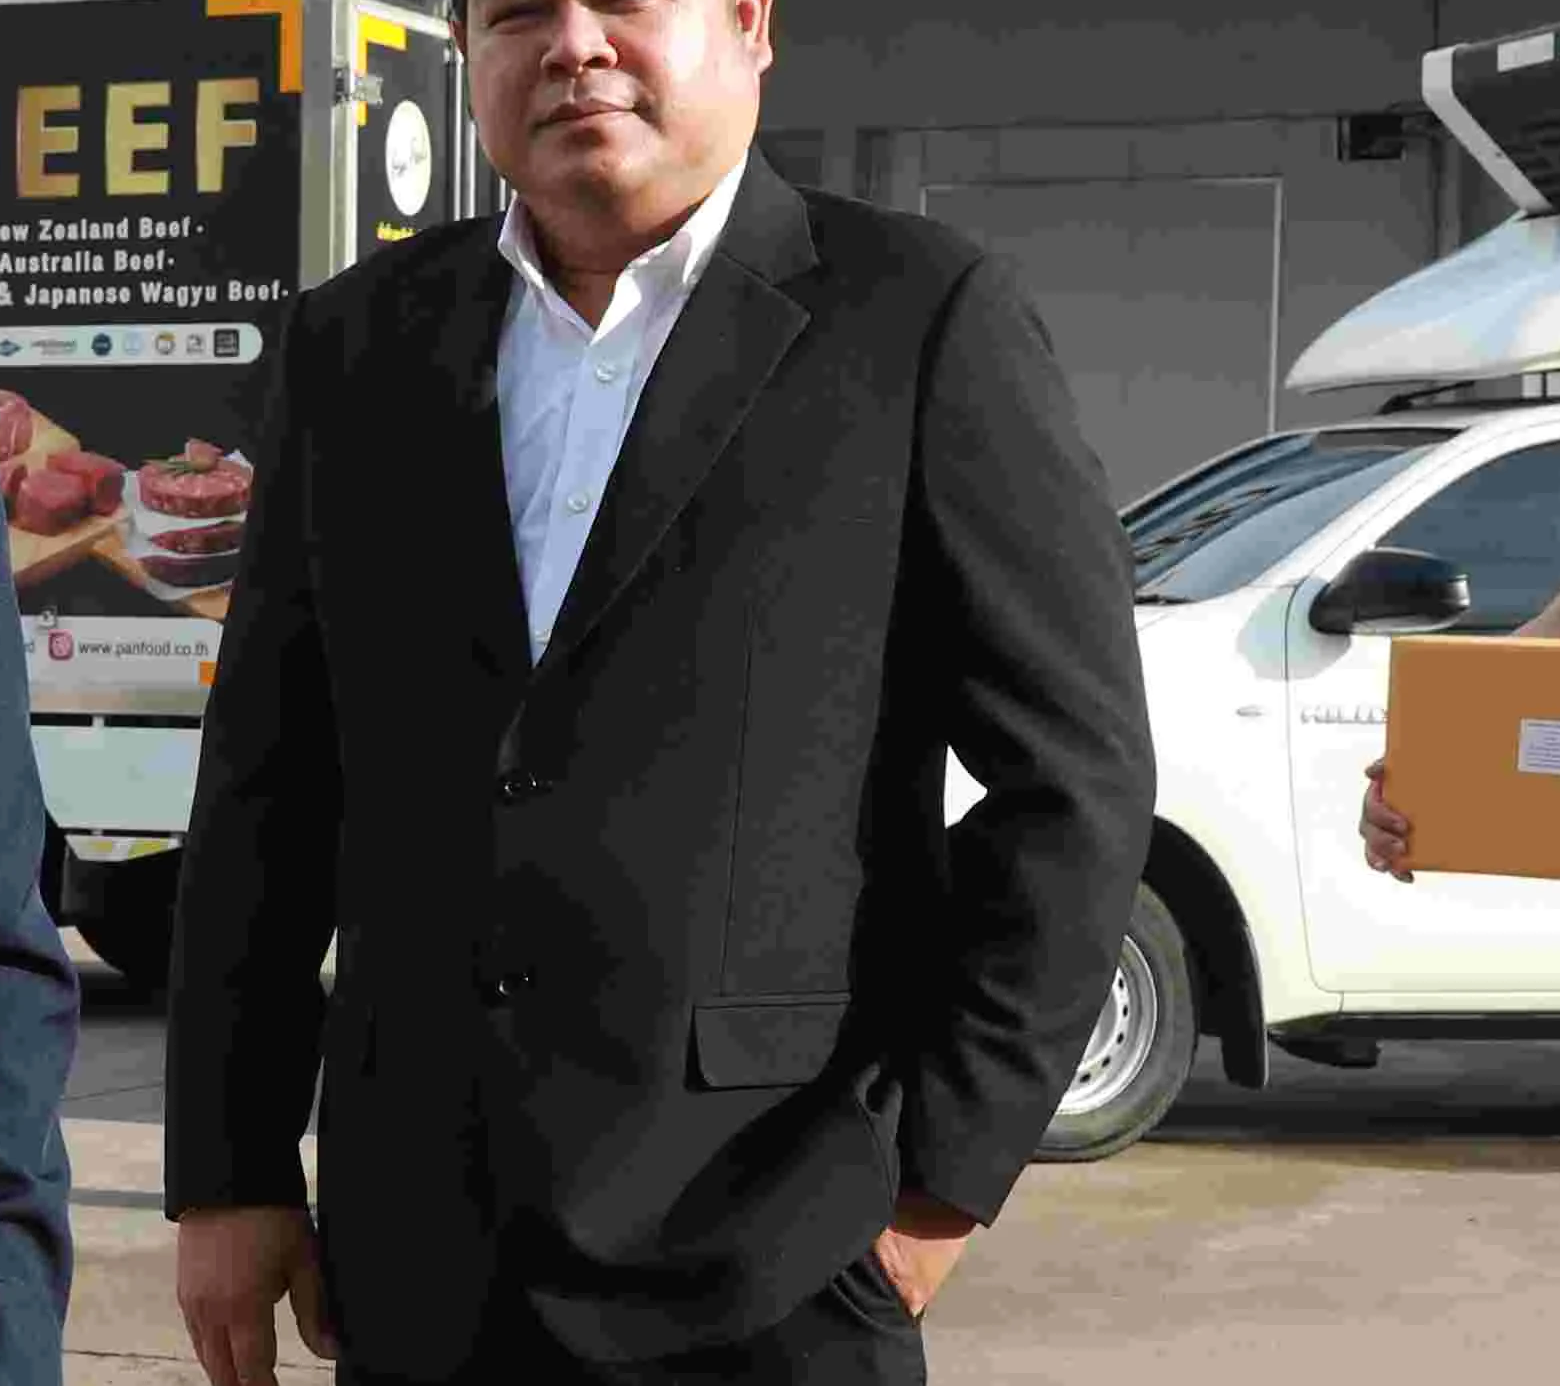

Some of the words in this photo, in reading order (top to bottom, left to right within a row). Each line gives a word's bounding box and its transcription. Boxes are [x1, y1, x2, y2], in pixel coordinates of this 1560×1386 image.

[39, 217, 129, 241] Zealand
[139, 215, 192, 239] Beef
[114, 249, 166, 272] Beef
[25, 283, 131, 309] Japanese
[140, 281, 218, 307] Wagyu
[227, 279, 281, 302] Beef
